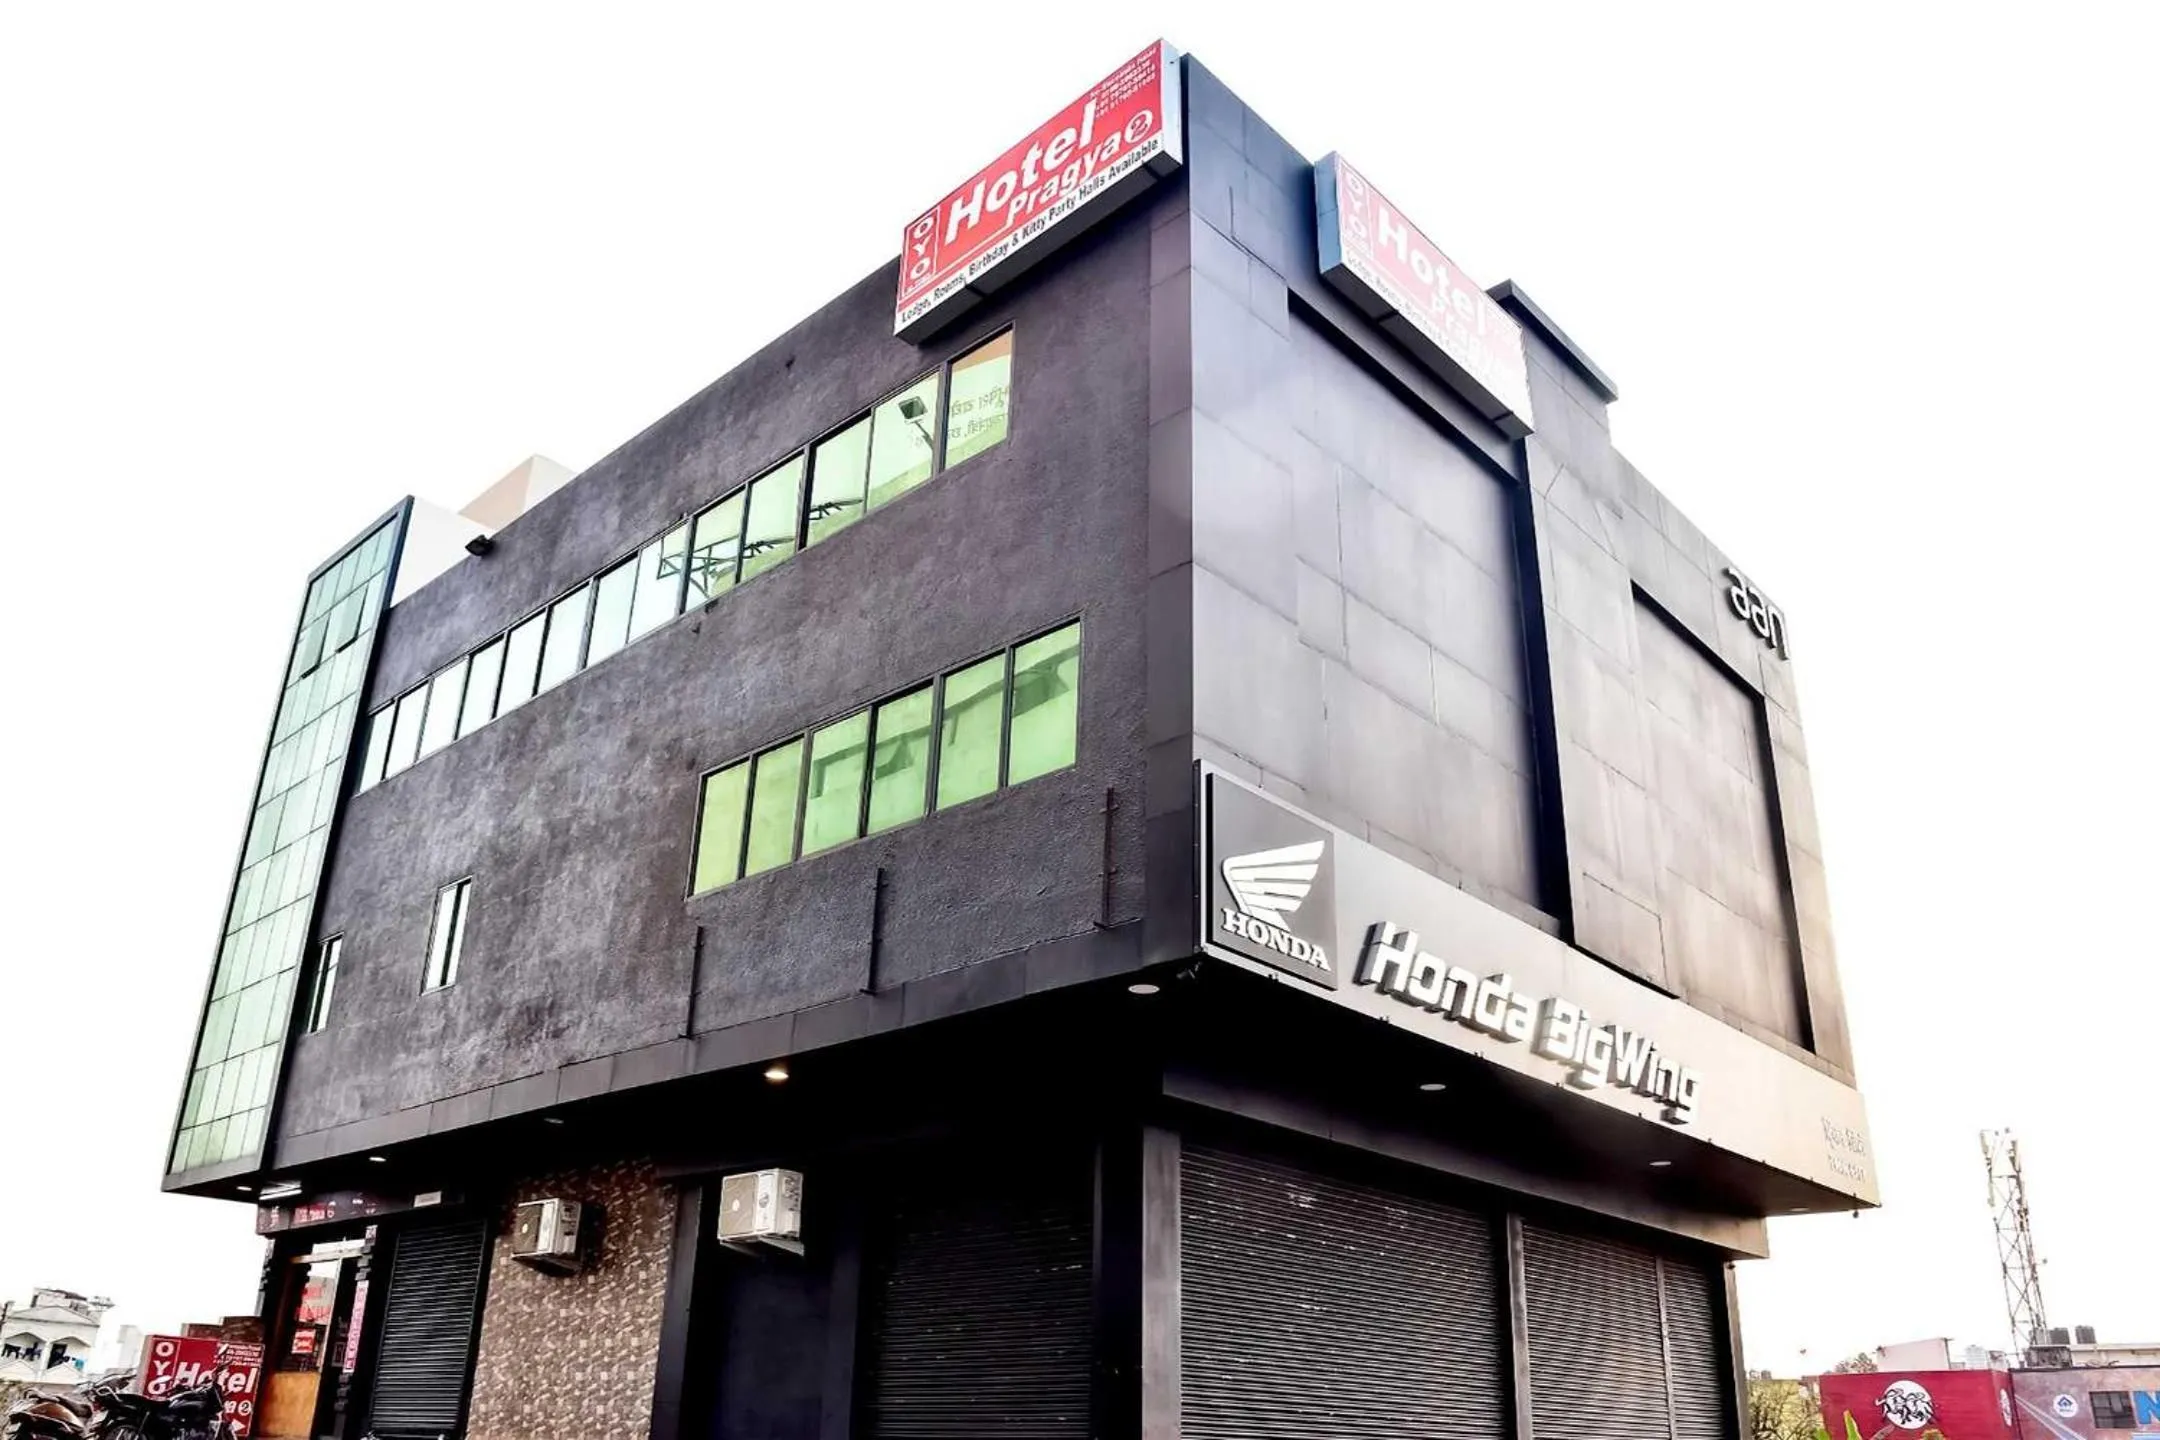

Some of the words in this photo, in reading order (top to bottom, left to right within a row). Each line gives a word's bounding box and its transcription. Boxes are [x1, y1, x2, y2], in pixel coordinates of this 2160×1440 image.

[944, 97, 1097, 246] Hotel
[968, 242, 1009, 276] Birthday
[1021, 216, 1047, 239] Kitty
[1049, 196, 1076, 220] Party
[1108, 139, 1158, 180] Available
[1004, 130, 1121, 228] Pragya
[912, 217, 935, 280] OYO
[1378, 206, 1487, 336] Hotel
[1222, 907, 1331, 971] HONDA
[1358, 920, 1540, 1043] Honda
[1536, 997, 1700, 1125] BigWing
[147, 1341, 174, 1395] OYO
[173, 1362, 258, 1393] Hotel
